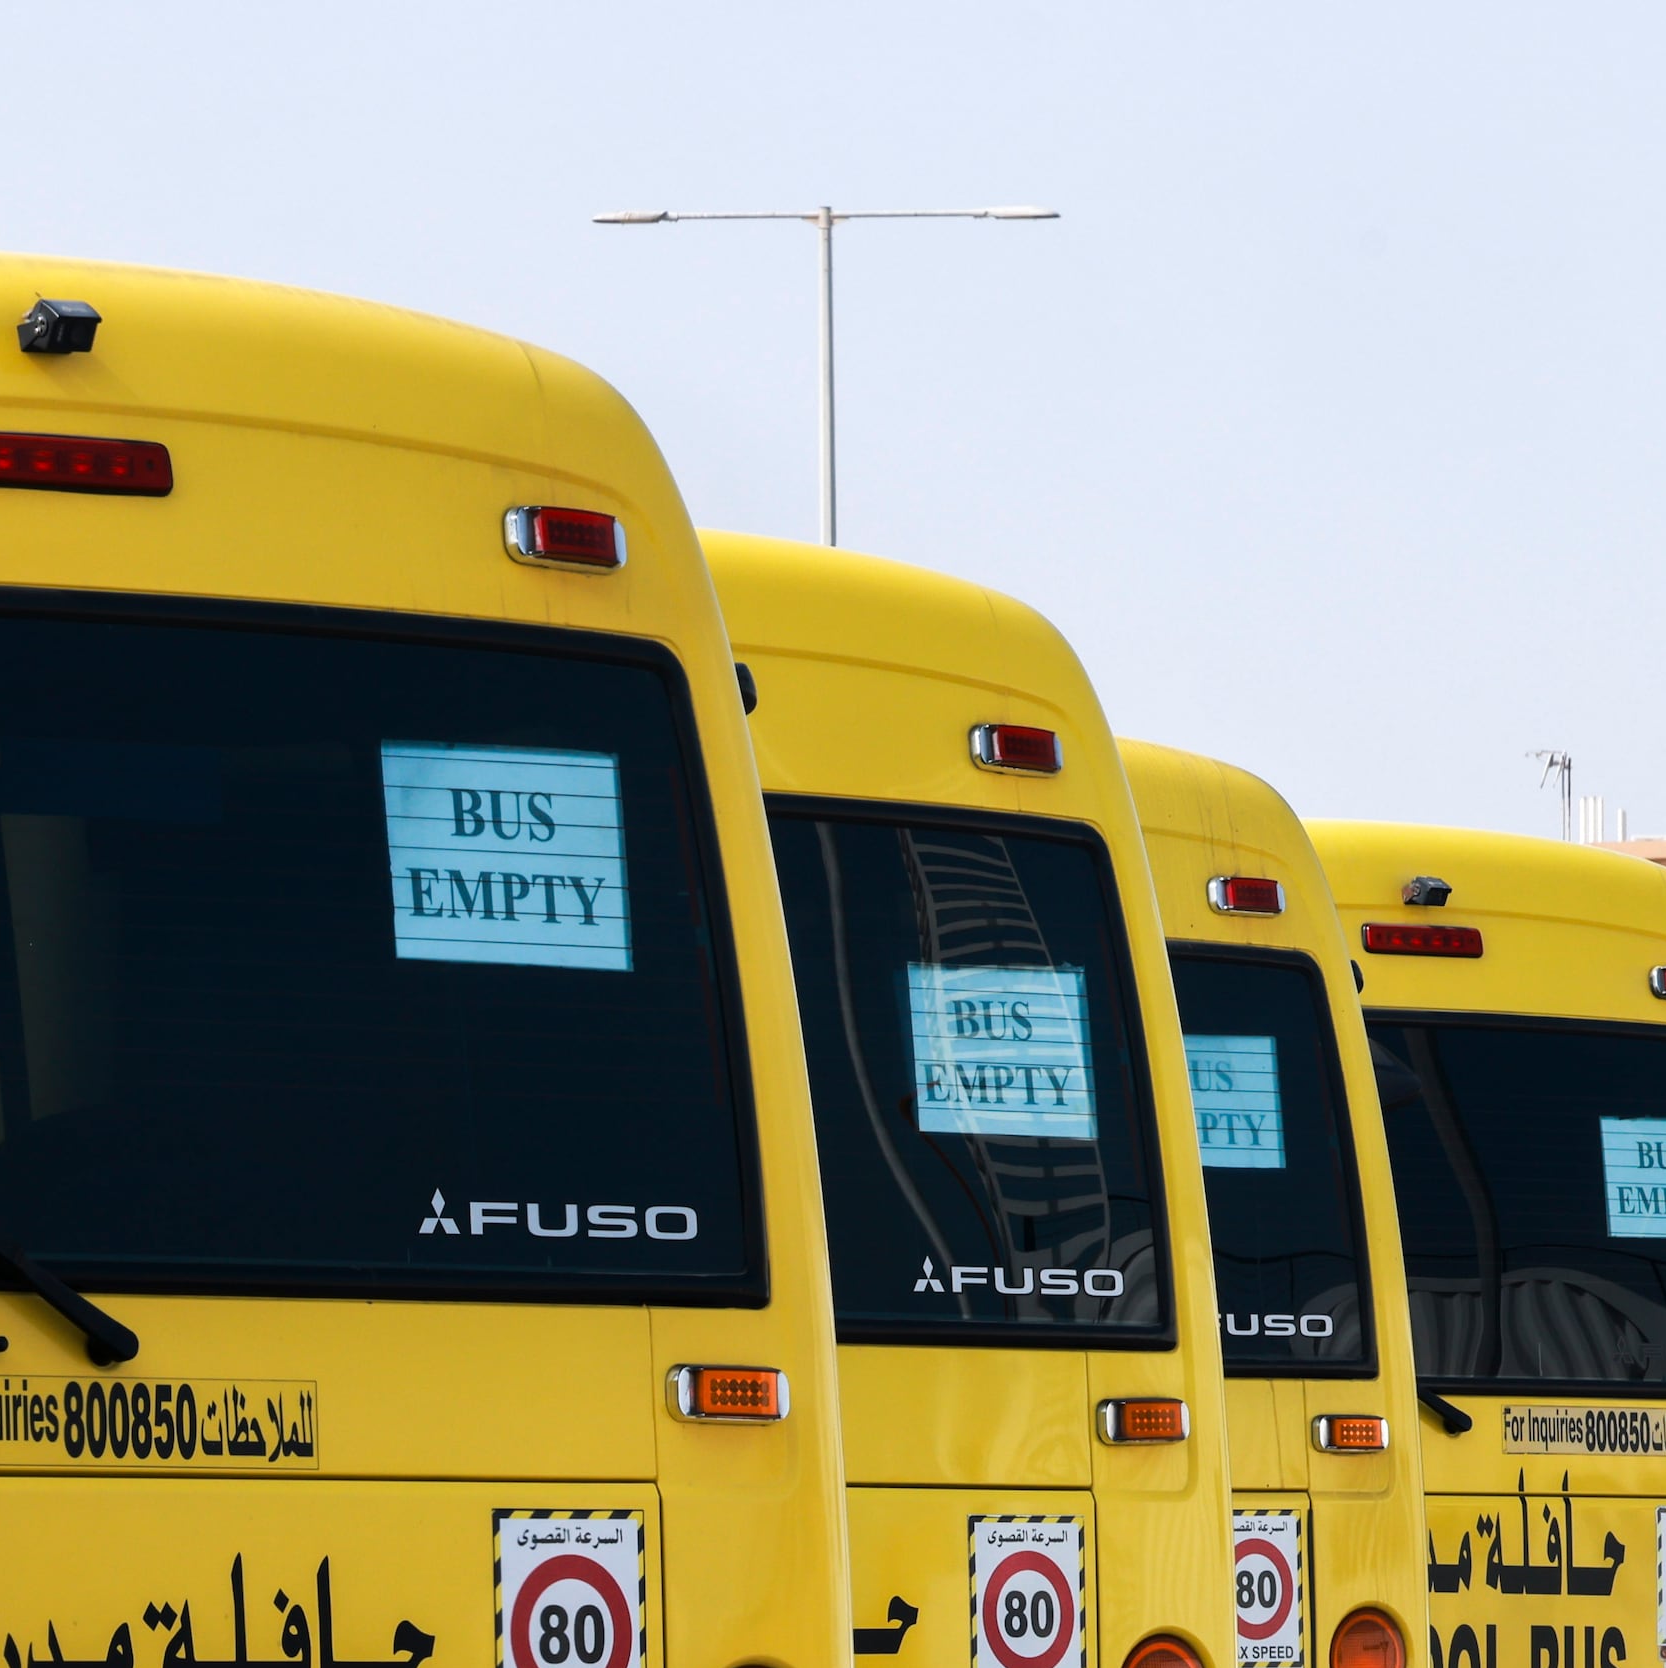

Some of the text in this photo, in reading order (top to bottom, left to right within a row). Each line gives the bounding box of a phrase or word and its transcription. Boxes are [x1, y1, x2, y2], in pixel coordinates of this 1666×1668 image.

[449, 787, 556, 843] BUS
[406, 867, 605, 926] EMPTY
[952, 999, 1032, 1041] BUS
[919, 1063, 1072, 1106] EMPTY
[1189, 1060, 1233, 1093] US
[469, 1201, 698, 1241] FUSO
[950, 1266, 1124, 1297] FUSO
[1219, 1313, 1333, 1337] USO
[63, 1381, 197, 1459] 800850
[201, 1384, 314, 1462] للملاحظات
[1503, 1408, 1525, 1441] For
[1528, 1409, 1582, 1451] Inquiries
[1585, 1410, 1650, 1453] 800850
[517, 1527, 623, 1550] السرعة القصوى
[988, 1529, 1067, 1547] السرعة القصوى
[1258, 1521, 1288, 1535] السرعة
[1476, 1467, 1626, 1596] حافلة
[1237, 1570, 1276, 1608] 80
[539, 1604, 604, 1664] 80
[1004, 1591, 1054, 1638] 80
[1252, 1646, 1294, 1659] SPEED
